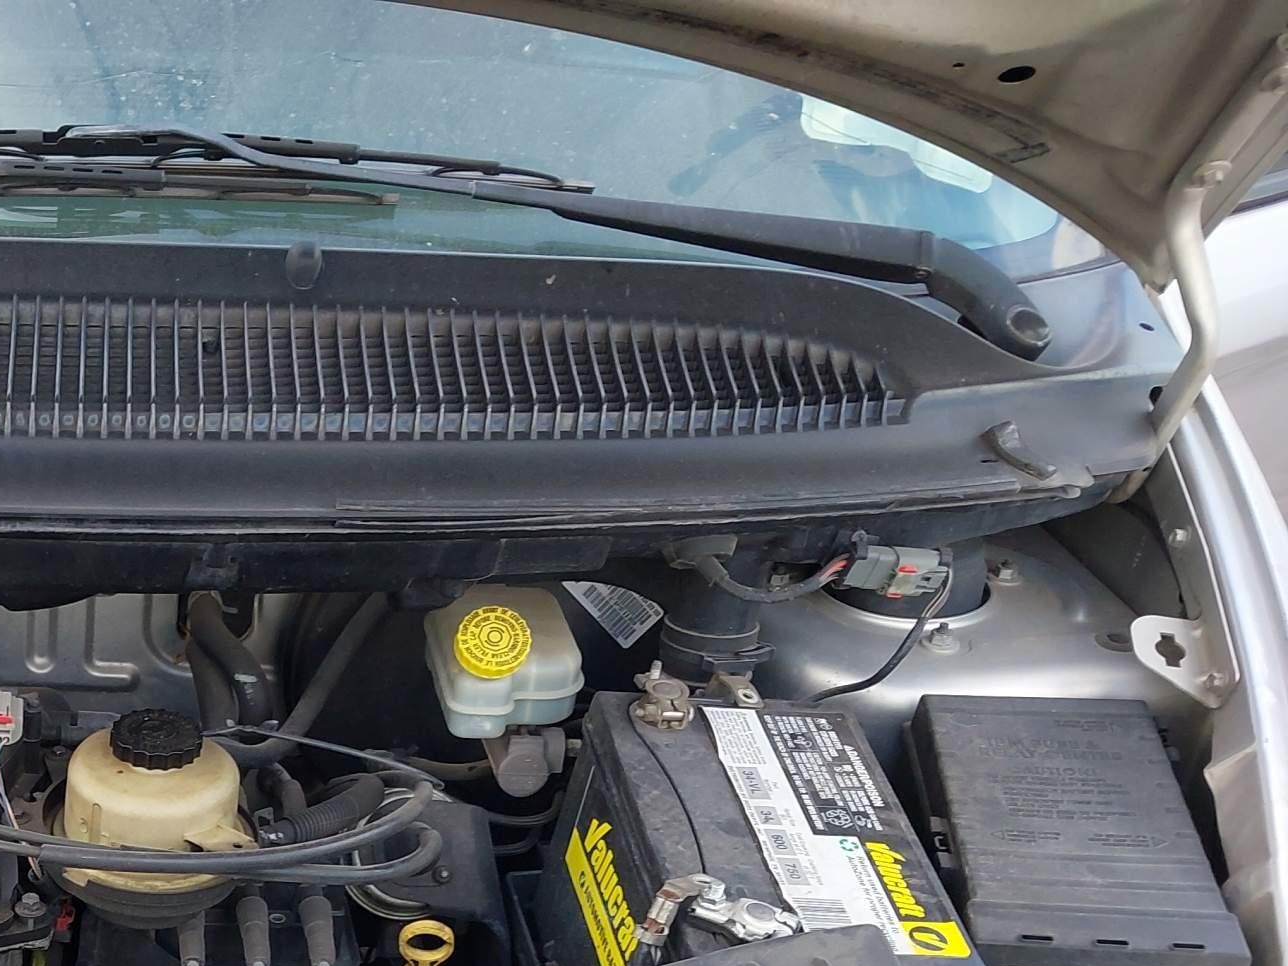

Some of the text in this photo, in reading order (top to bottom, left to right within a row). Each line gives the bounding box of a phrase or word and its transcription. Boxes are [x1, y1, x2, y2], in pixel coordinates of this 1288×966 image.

[772, 834, 788, 850] 600
[785, 863, 801, 880] 750
[865, 842, 926, 918] Valucraft
